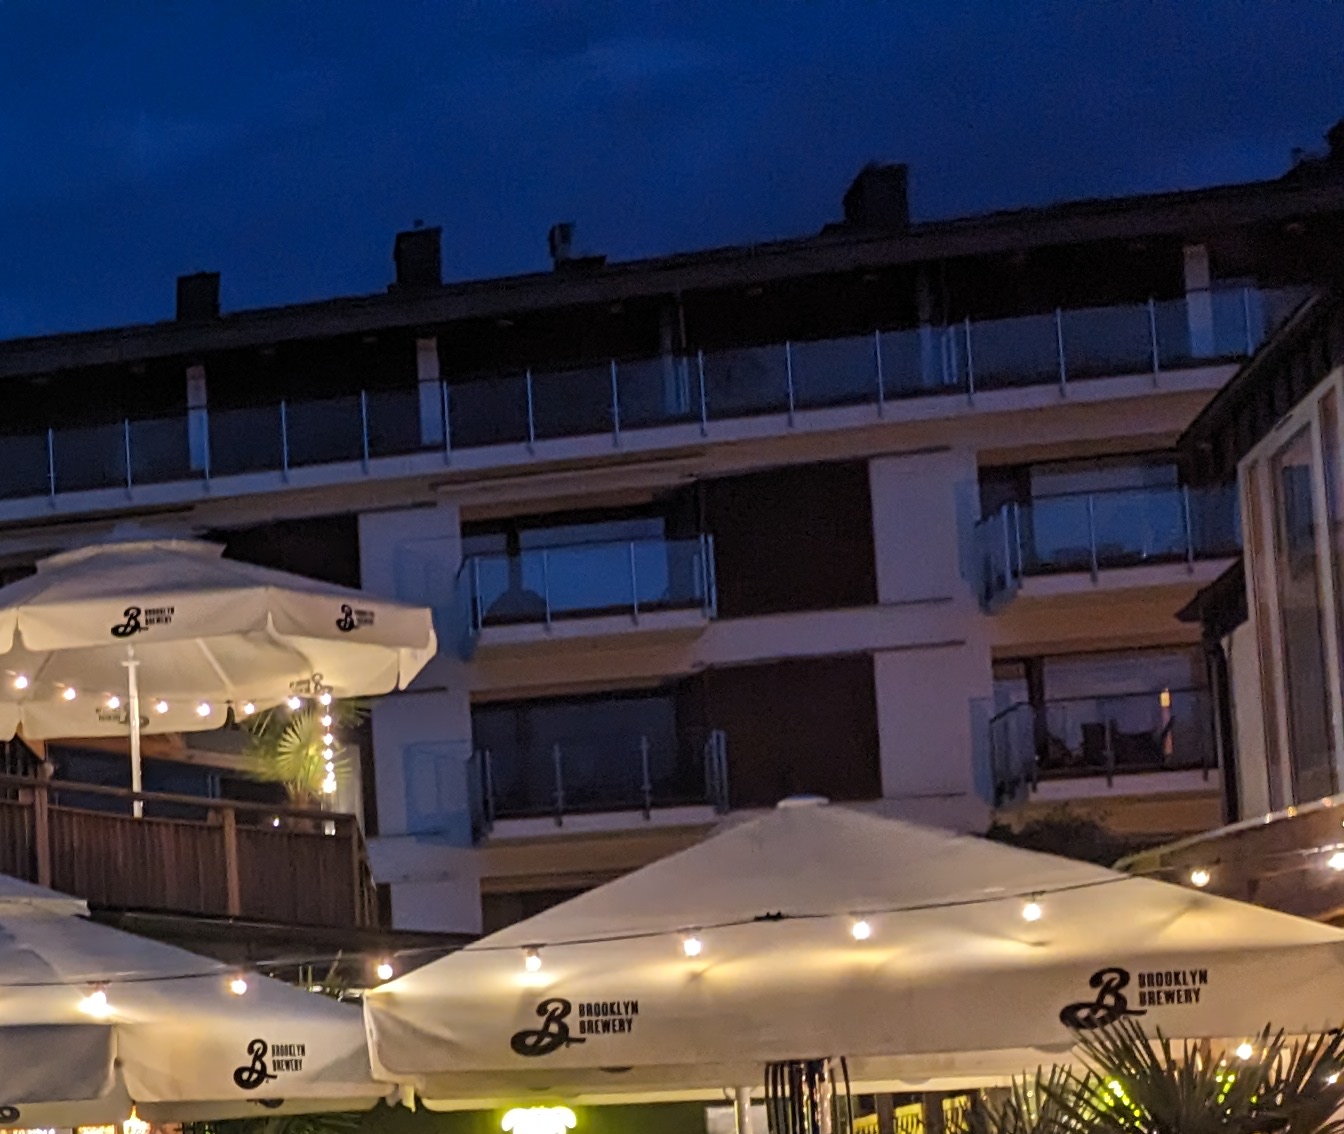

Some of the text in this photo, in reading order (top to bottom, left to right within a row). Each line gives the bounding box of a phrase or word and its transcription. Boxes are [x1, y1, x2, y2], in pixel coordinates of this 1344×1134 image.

[1138, 969, 1208, 988] BROOKLYN
[1138, 987, 1201, 1007] BREWERY
[578, 1001, 639, 1018] BROOKLYN
[579, 1017, 633, 1034] BREWERY
[271, 1044, 306, 1057] BROOKLYN
[272, 1058, 303, 1072] BREWERY
